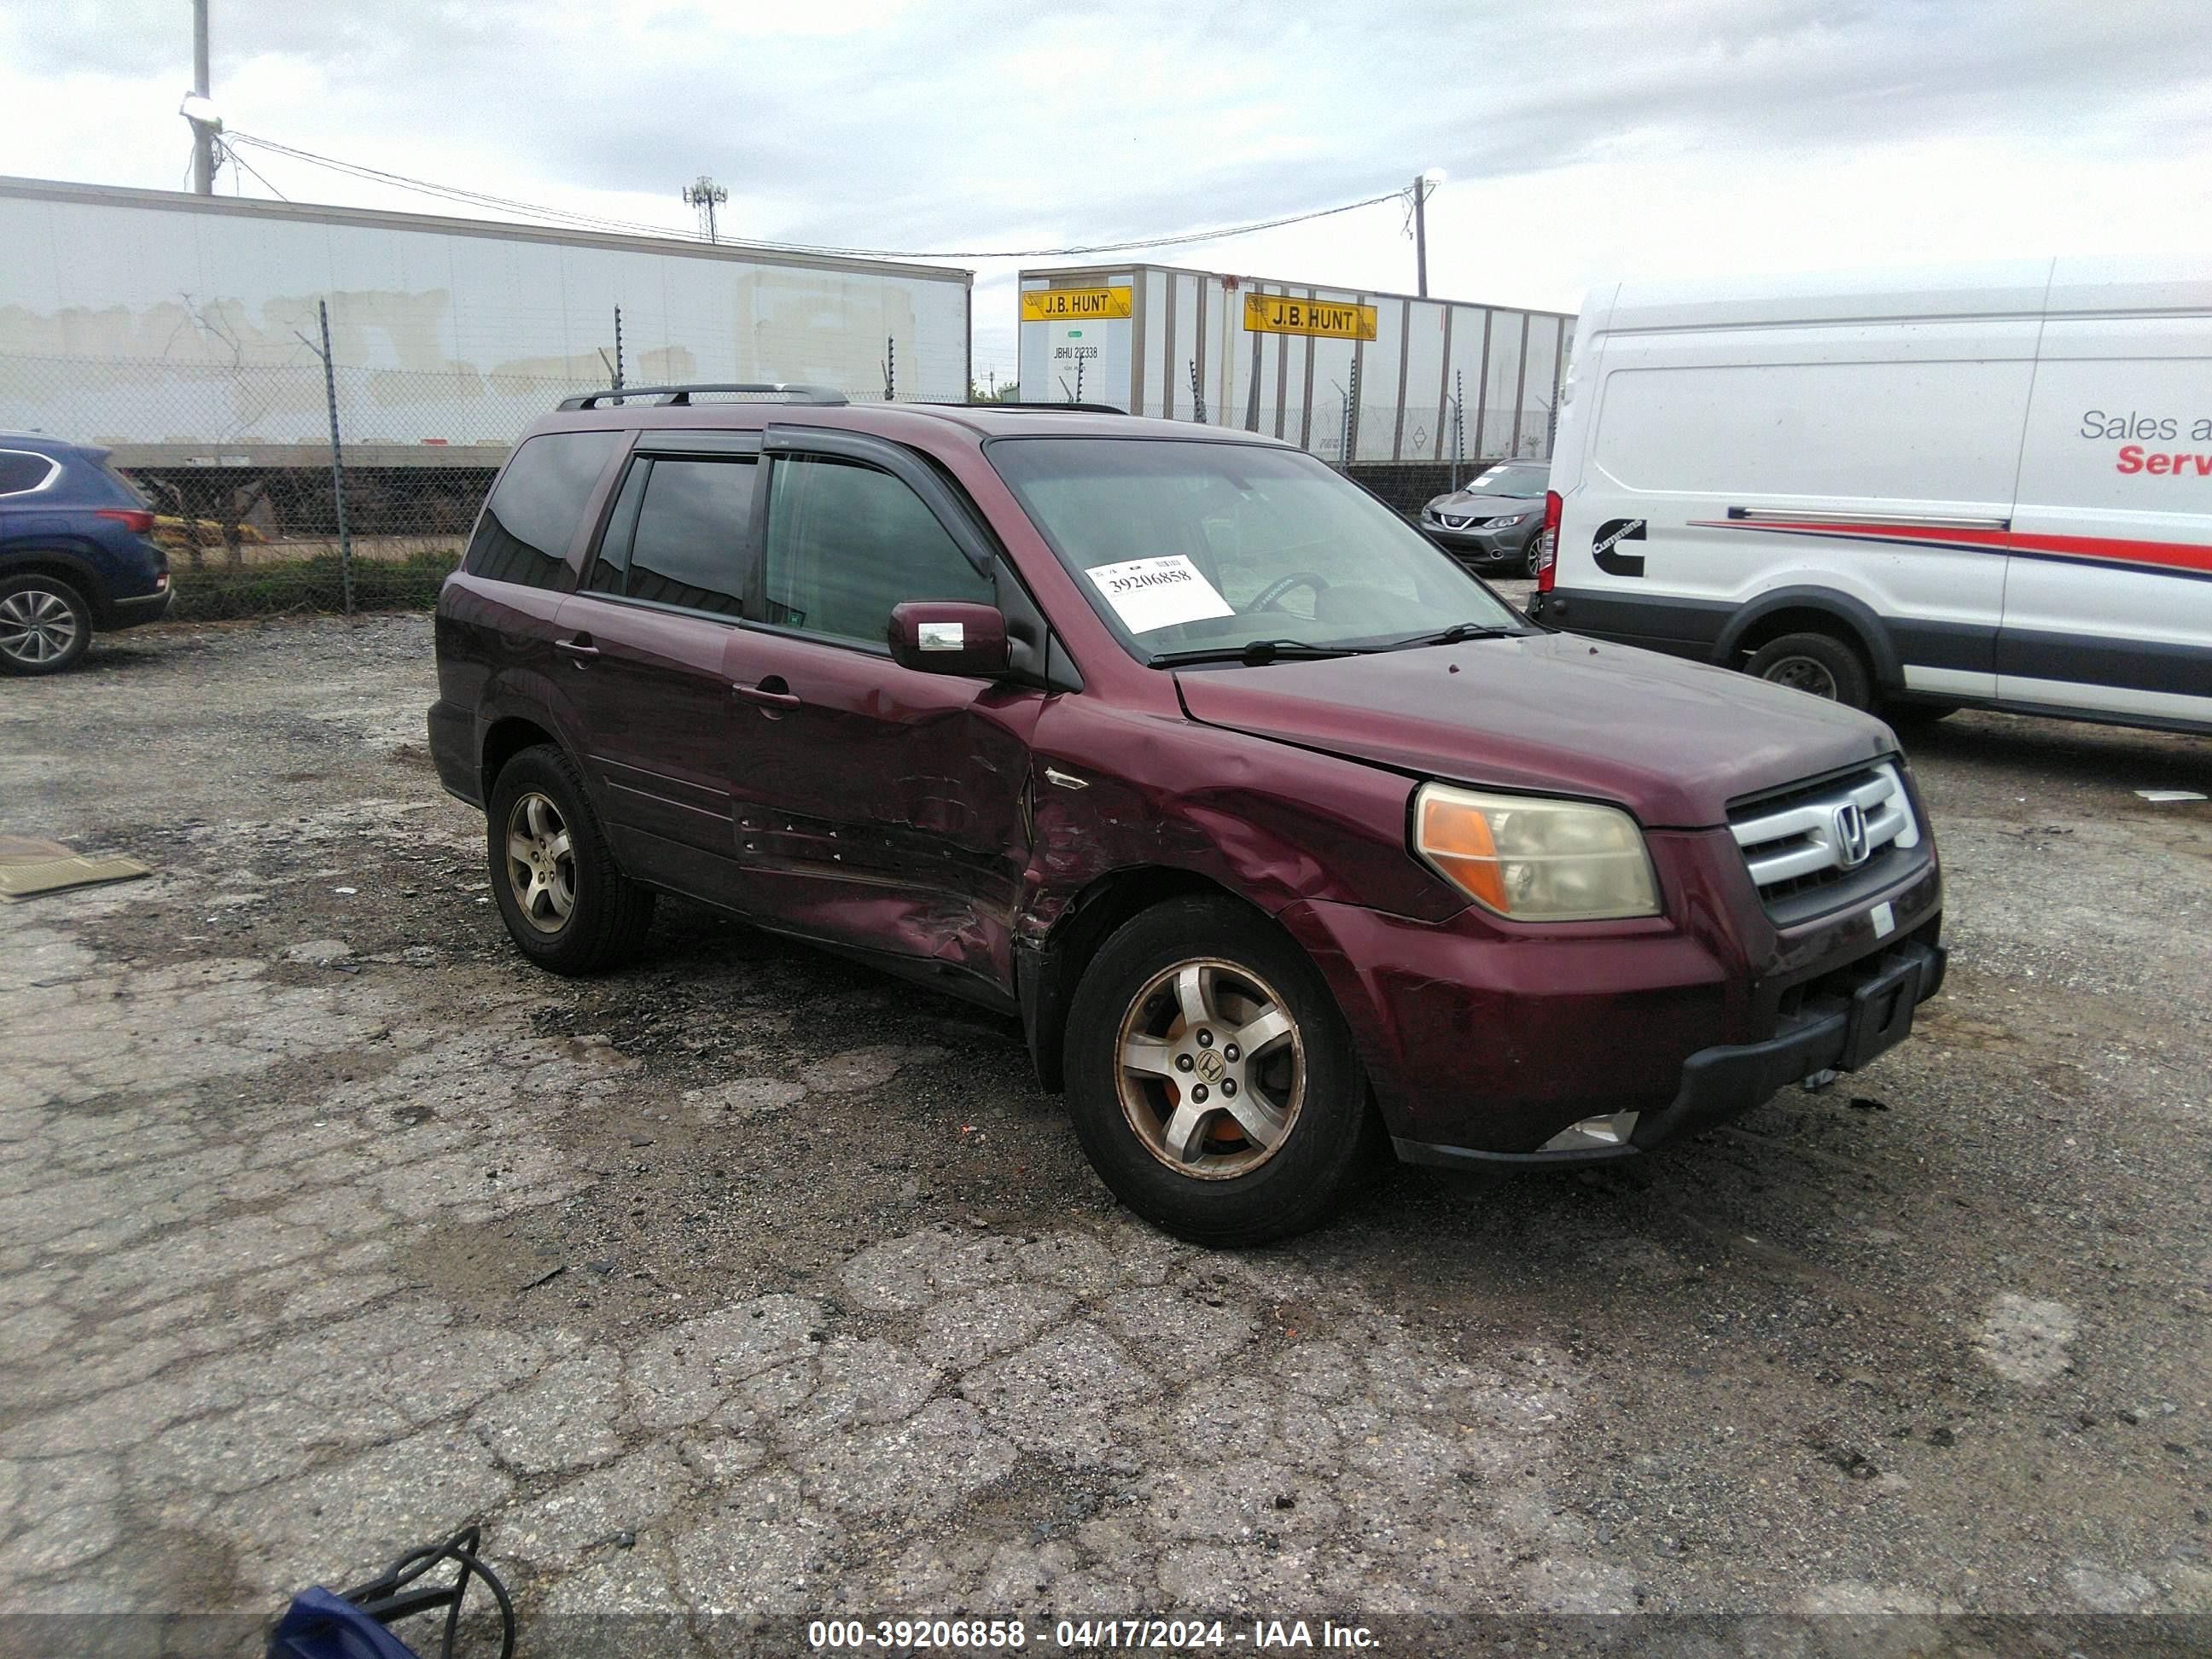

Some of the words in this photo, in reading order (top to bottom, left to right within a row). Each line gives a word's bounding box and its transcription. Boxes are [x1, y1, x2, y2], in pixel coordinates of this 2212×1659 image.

[1045, 295, 1069, 313] J.B.
[1072, 293, 1109, 312] HUNT
[1272, 305, 1304, 327] J.B.
[1309, 306, 1354, 331] HUNT
[1054, 347, 1073, 358] JBHU
[2081, 410, 2178, 440] Sales
[1592, 519, 1643, 555] Cummins
[1109, 569, 1192, 594] 39206858
